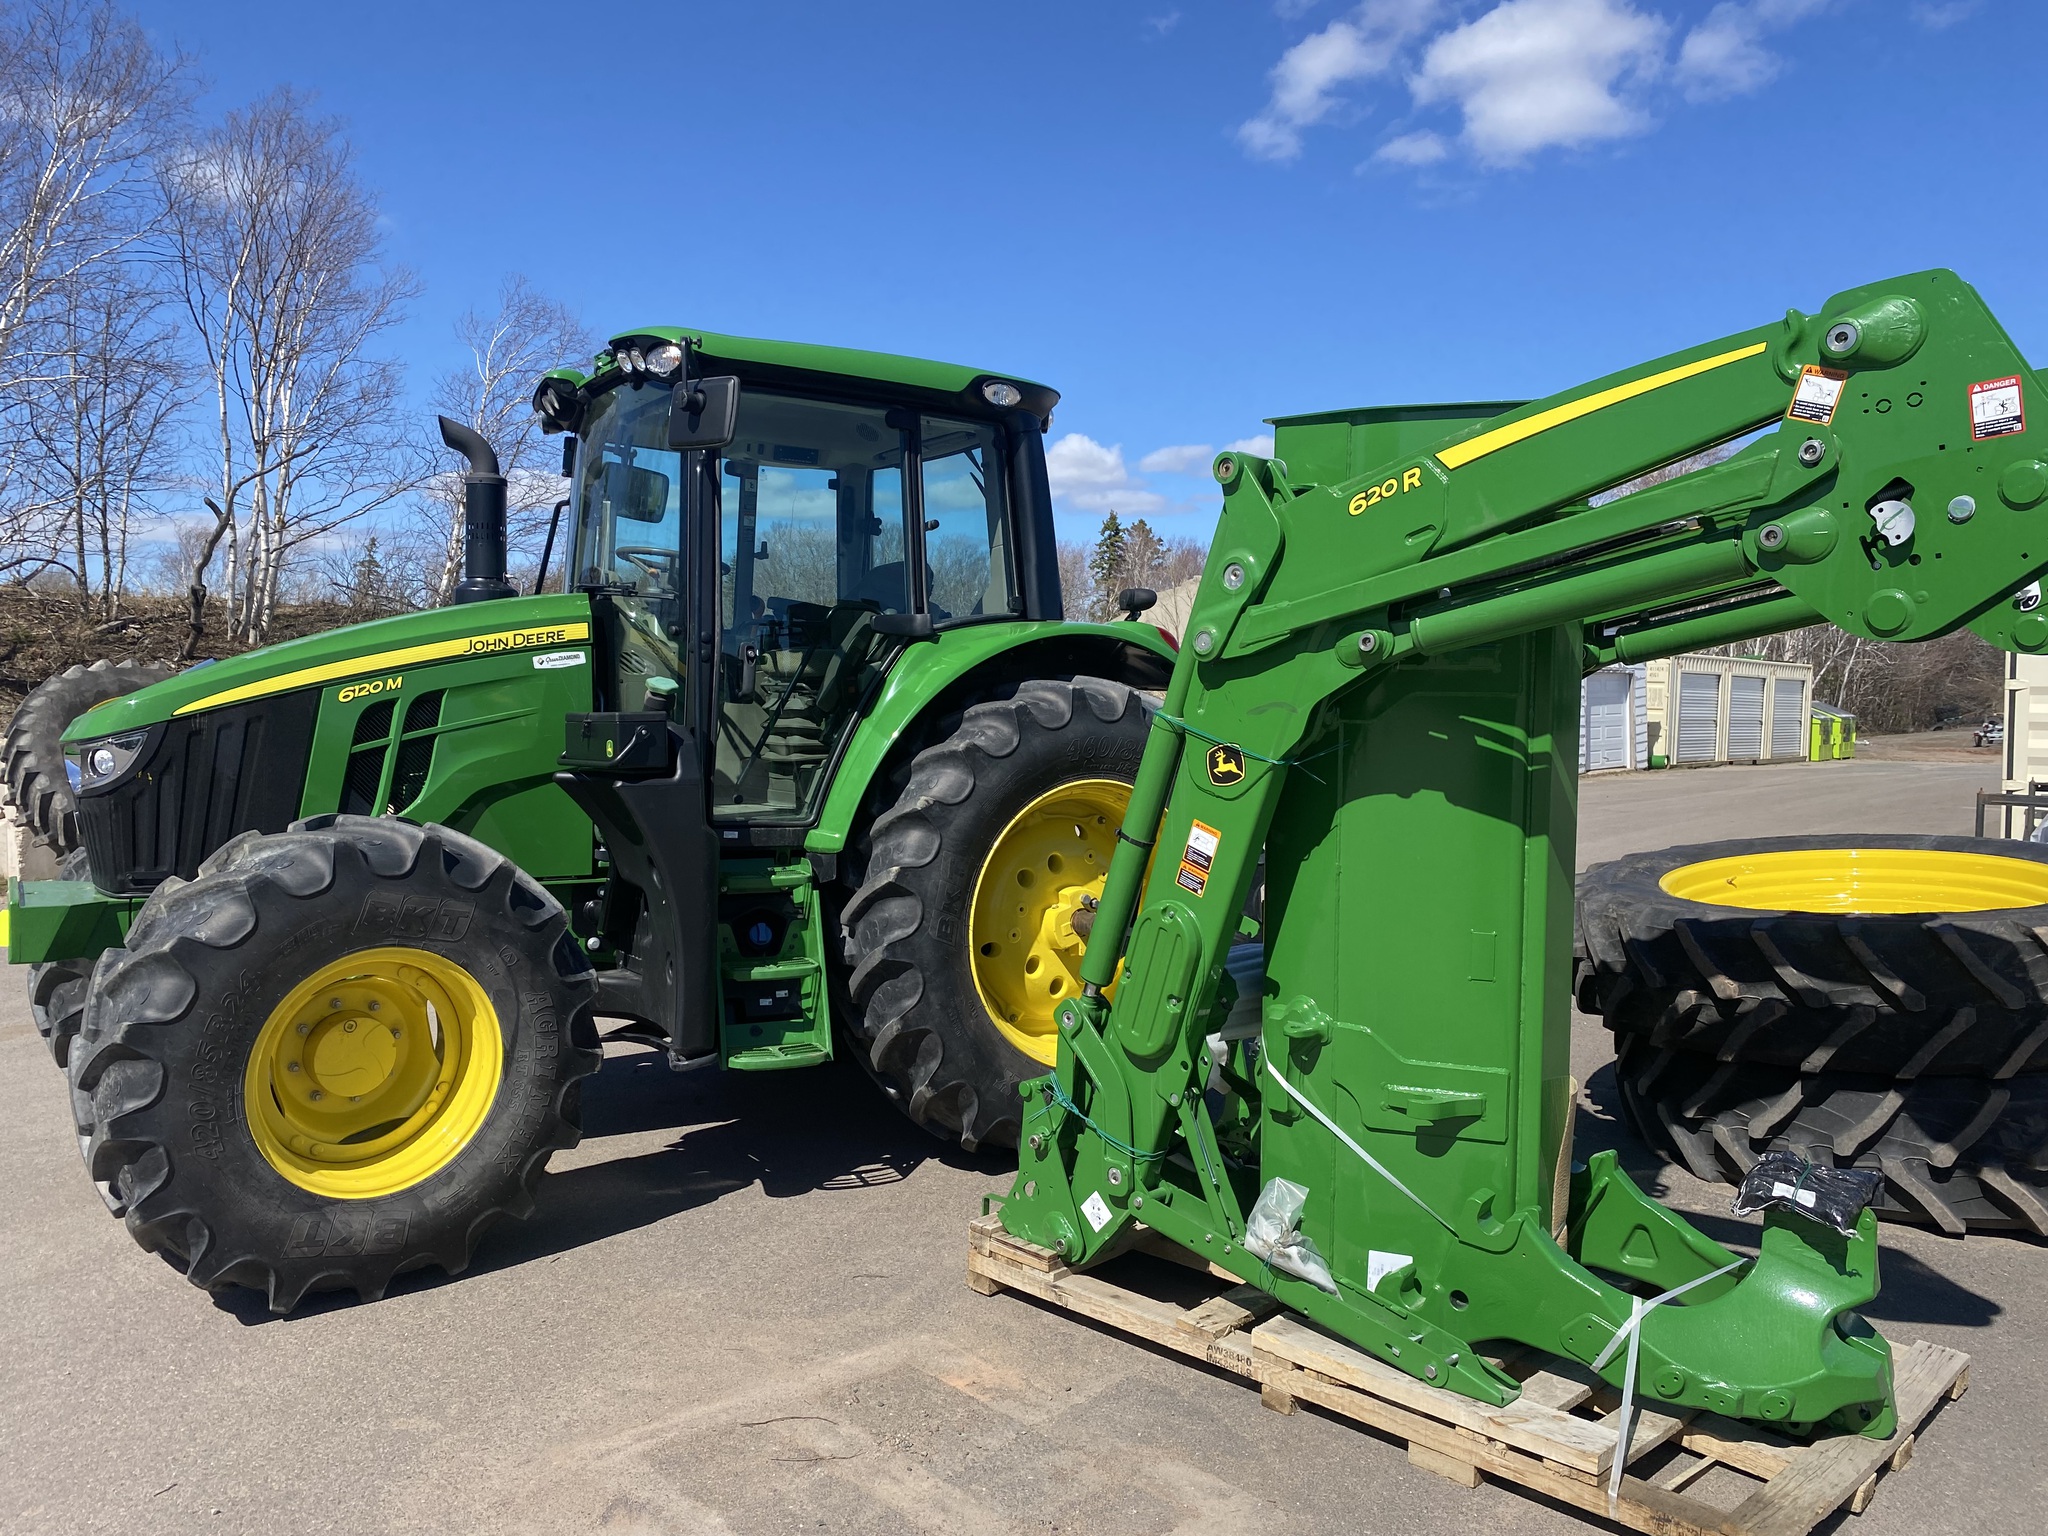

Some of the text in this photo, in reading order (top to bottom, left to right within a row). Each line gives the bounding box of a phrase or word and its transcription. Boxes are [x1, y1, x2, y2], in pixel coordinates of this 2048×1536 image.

[1814, 368, 1845, 379] WARNING
[1983, 378, 2017, 390] DANGER
[1348, 465, 1424, 516] 620 R
[464, 629, 566, 655] JOHN DEERE
[337, 676, 403, 704] 6120 M
[357, 898, 473, 938] BKT
[288, 1214, 410, 1252] BKT
